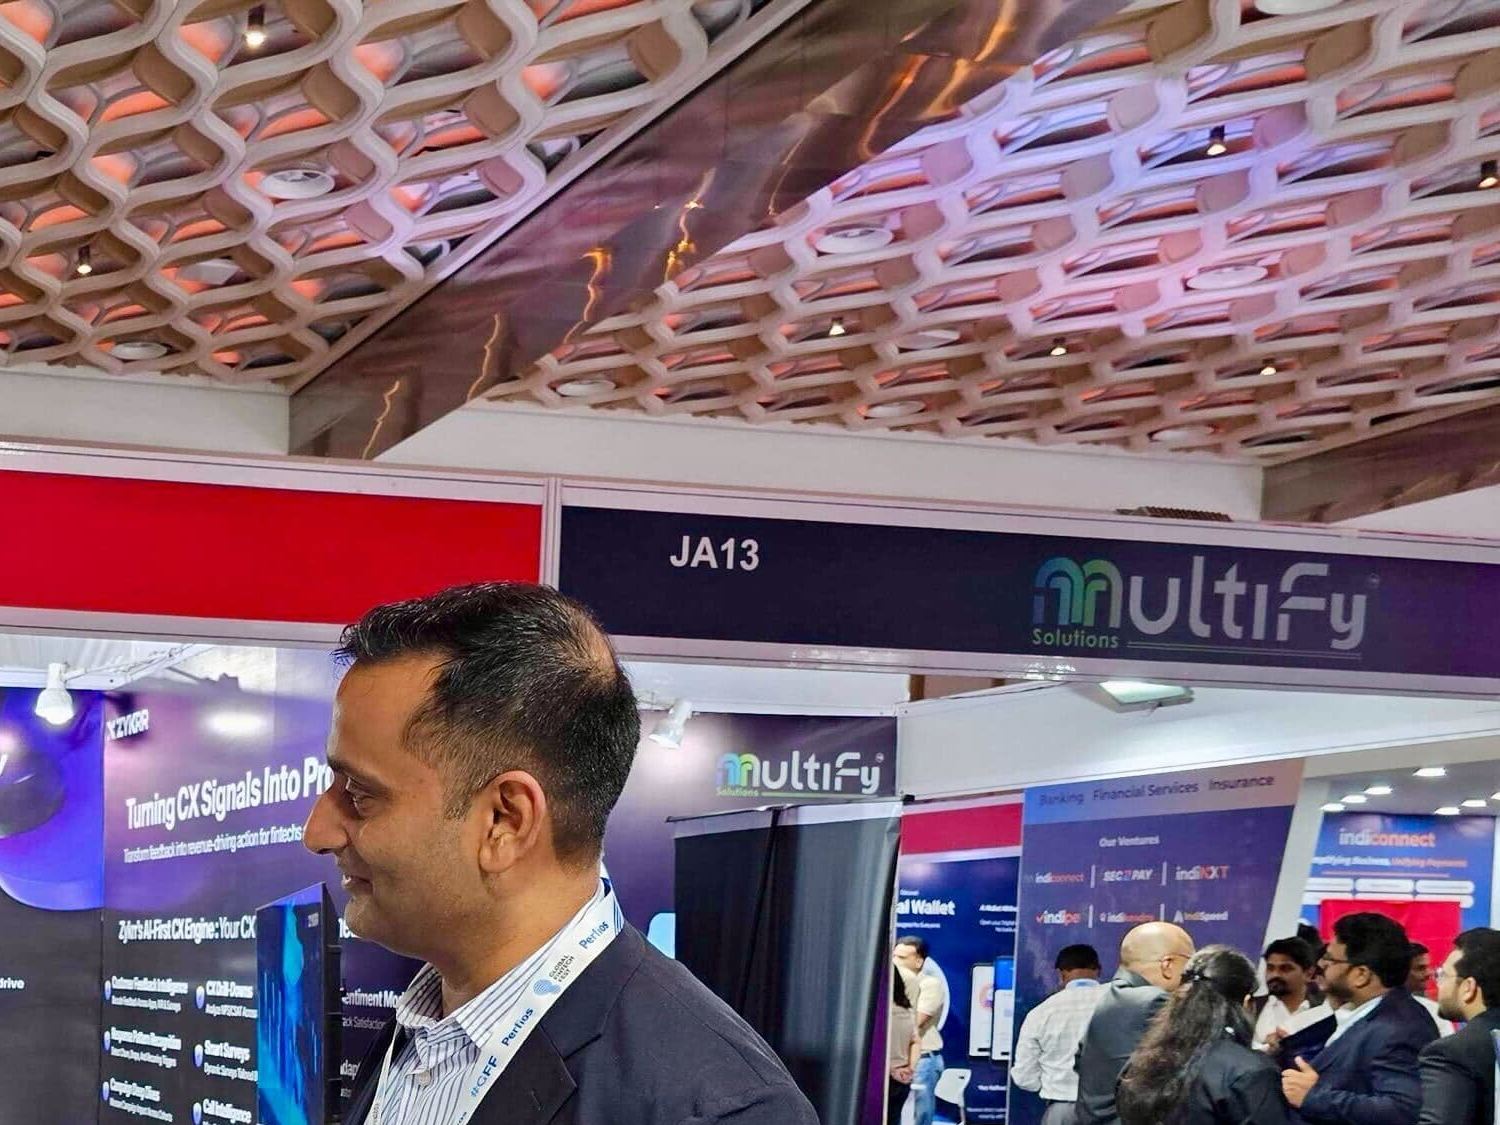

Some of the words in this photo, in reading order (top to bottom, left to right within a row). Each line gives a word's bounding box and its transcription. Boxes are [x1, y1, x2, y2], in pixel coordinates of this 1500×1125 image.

[669, 535, 760, 572] JA13
[1032, 628, 1119, 649] Solutions
[126, 793, 176, 831] Turning
[178, 784, 200, 821] CX
[201, 771, 261, 821] Signals
[264, 764, 300, 805] Into
[1040, 792, 1085, 806] Banking
[1093, 785, 1146, 801] Financial
[1148, 781, 1199, 797] Services
[1209, 775, 1275, 791] Insurance
[237, 831, 259, 848] action
[259, 828, 270, 845] for
[1339, 828, 1436, 848] indiconnect
[896, 900, 910, 915] al
[911, 899, 956, 915] Wallet
[219, 917, 240, 939] Your
[240, 915, 256, 939] CX
[578, 921, 610, 949] Perfios
[342, 1017, 353, 1028] ack
[501, 1007, 534, 1047] Perfios
[471, 1055, 498, 1098] #GFF
